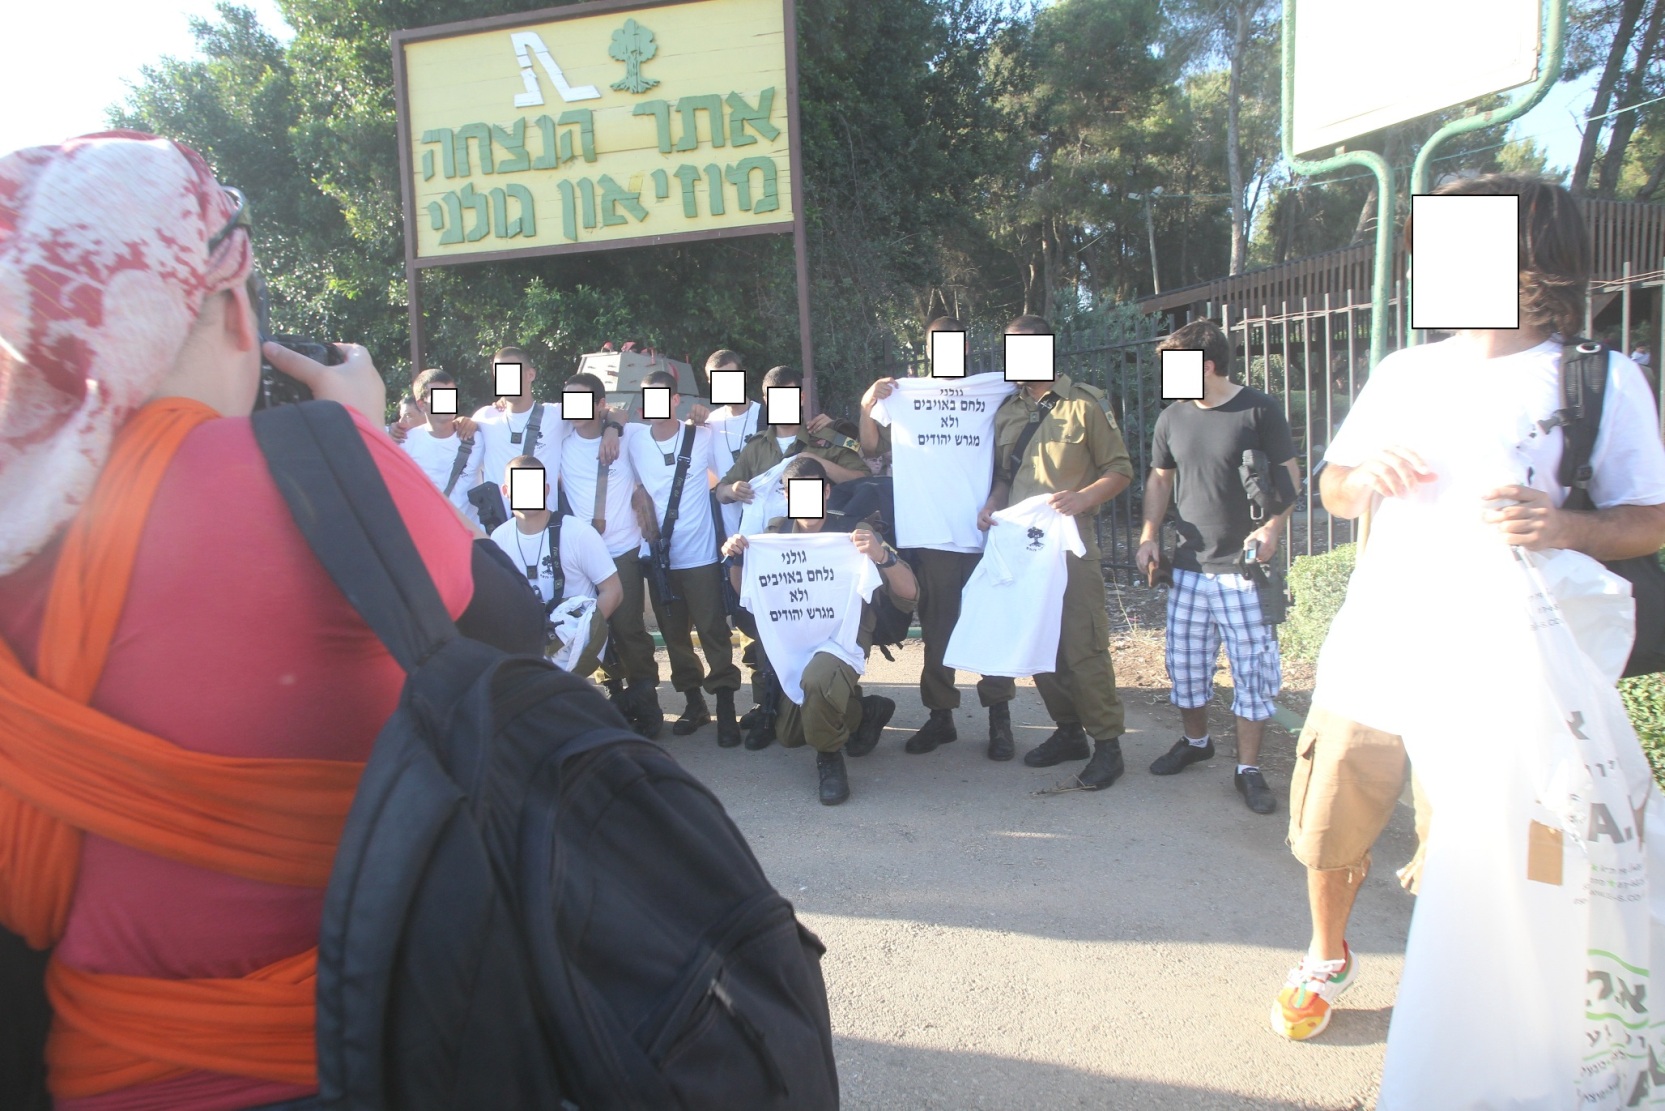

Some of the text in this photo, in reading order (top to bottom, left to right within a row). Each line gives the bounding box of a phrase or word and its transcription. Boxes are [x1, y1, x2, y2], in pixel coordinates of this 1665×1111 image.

[421, 86, 781, 182] אתר הנצחה
[427, 156, 780, 246] מוזיאון גולני
[913, 398, 986, 413] נלחם באויבים
[940, 414, 959, 428] ולא
[917, 433, 980, 447] מגרש יהודים
[781, 549, 807, 565] גולני
[758, 566, 835, 588] נלחם באויבים
[789, 587, 809, 603] ולא
[769, 606, 835, 622] מגרש יהודים
